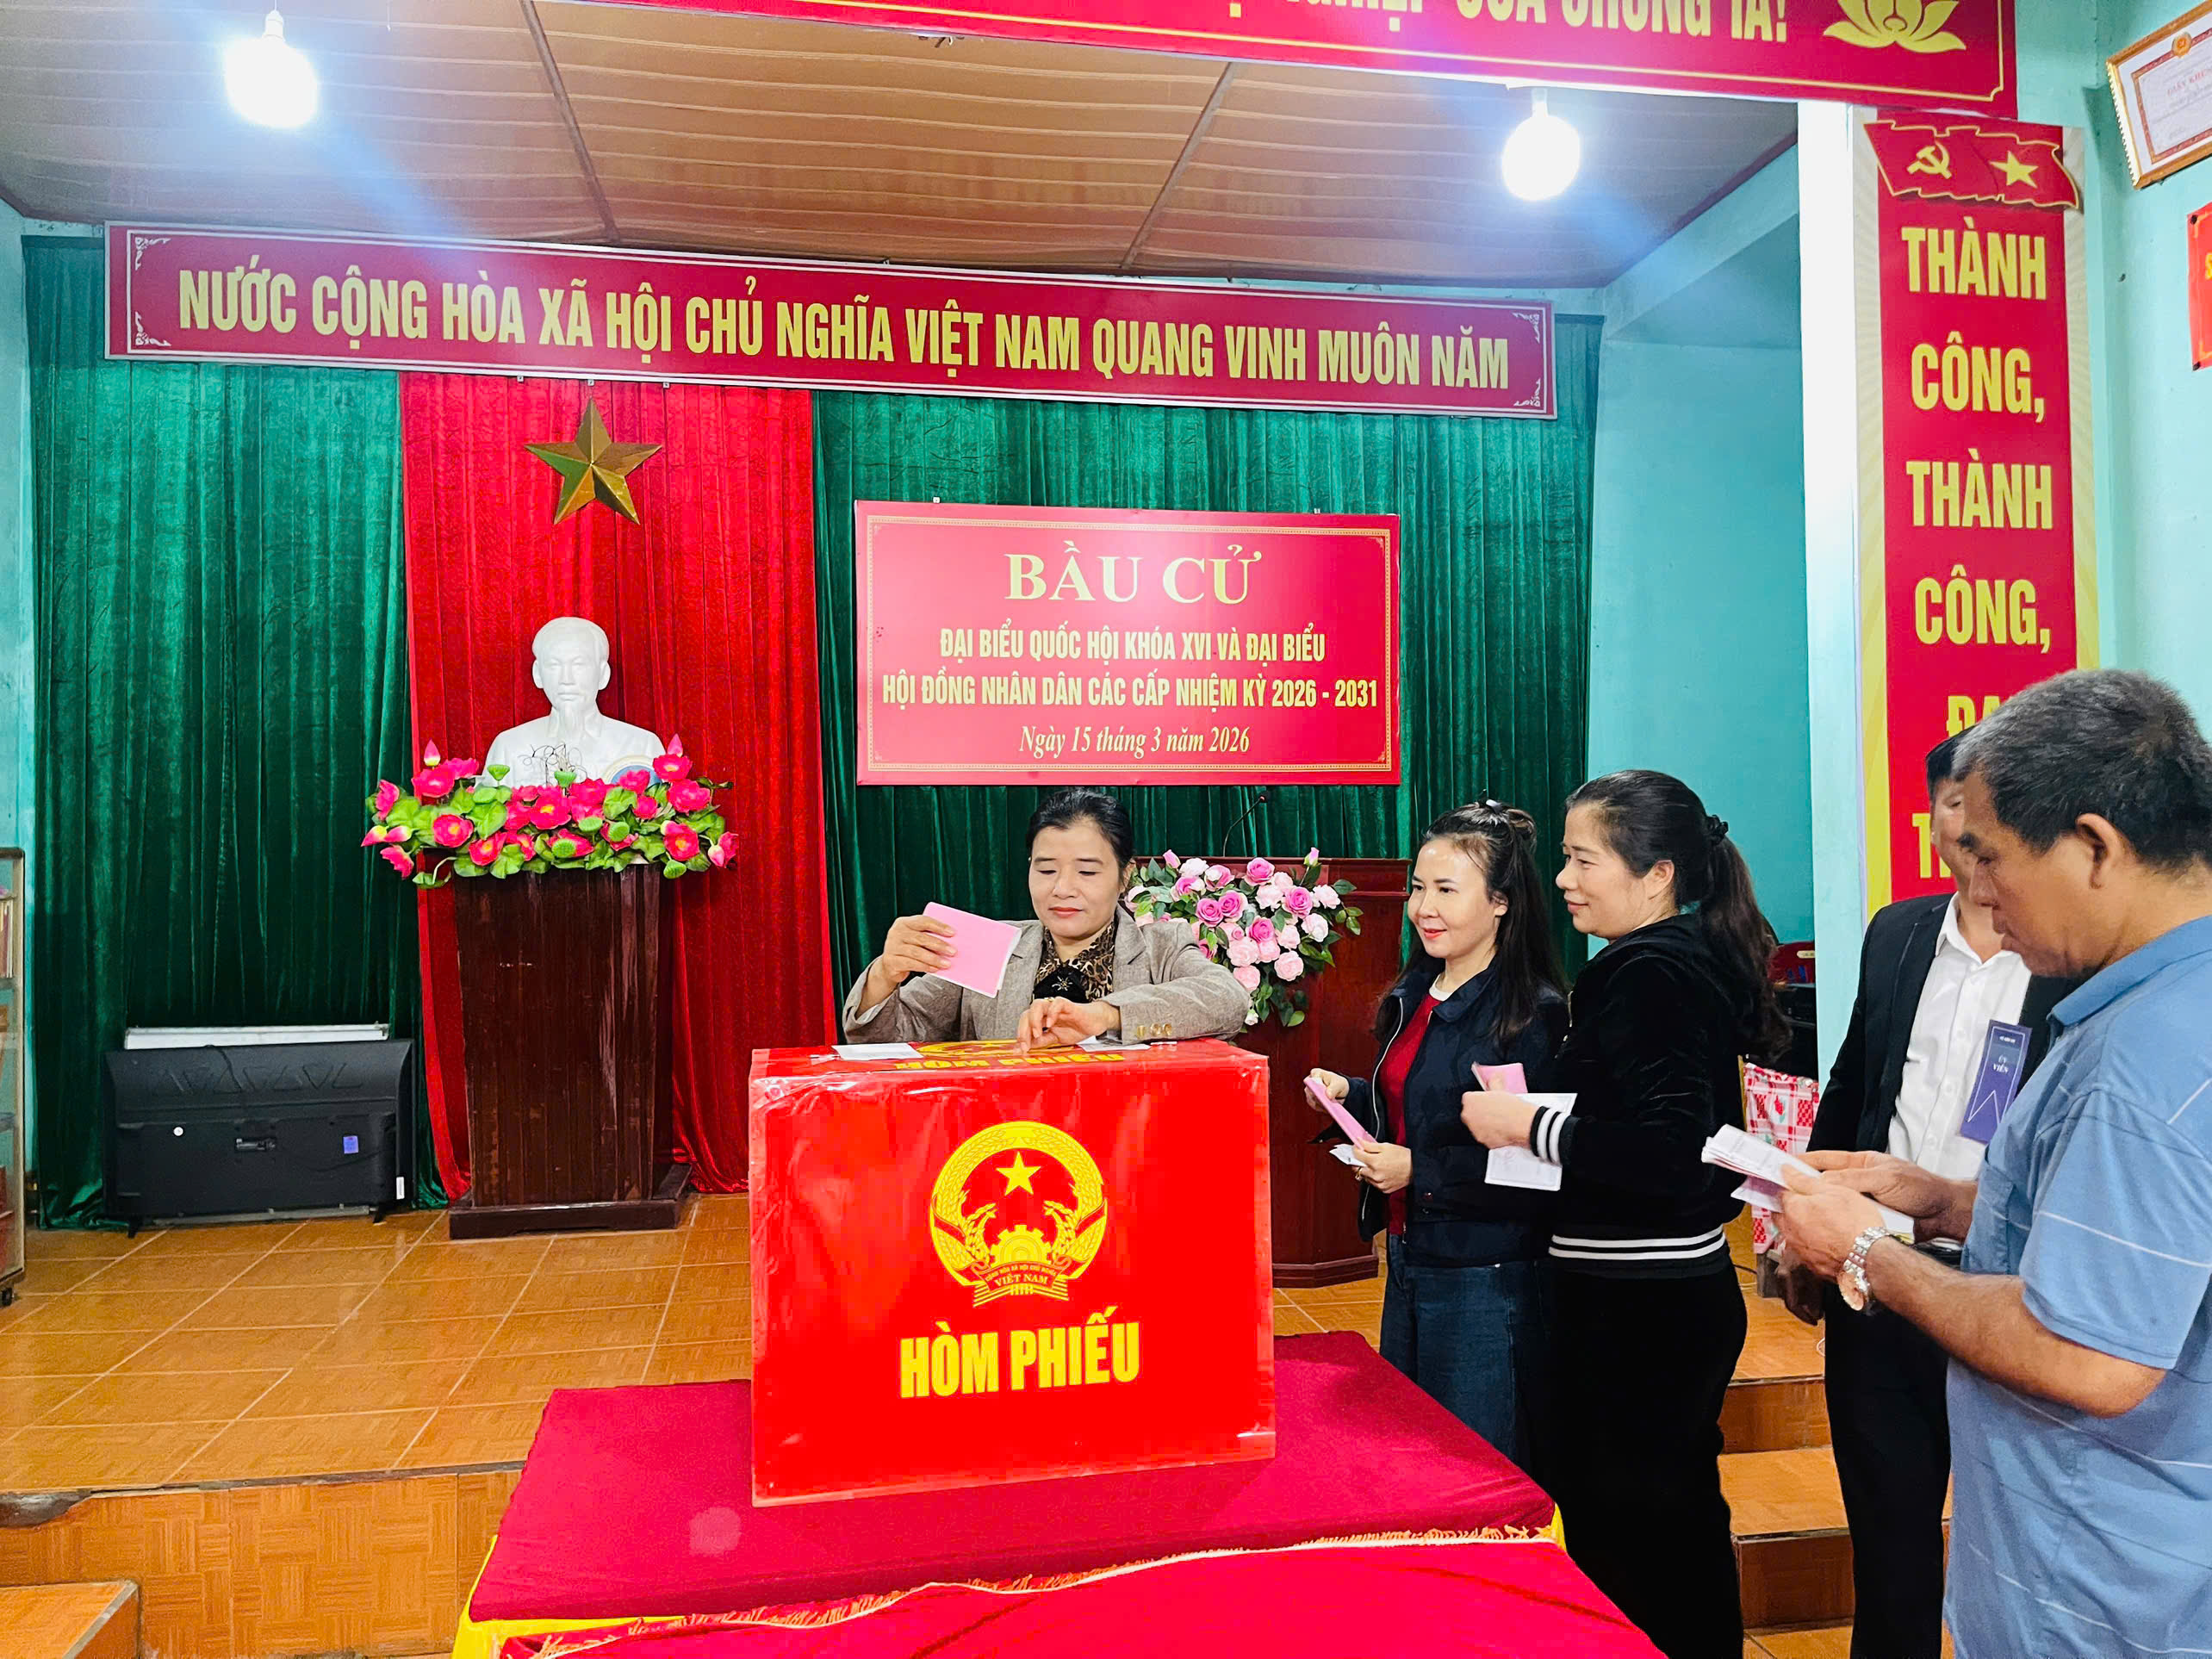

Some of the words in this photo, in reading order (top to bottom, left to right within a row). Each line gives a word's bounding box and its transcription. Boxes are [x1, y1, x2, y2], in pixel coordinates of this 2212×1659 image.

[1901, 216, 2047, 300] THÀNH
[179, 255, 297, 332] NƯỚC
[312, 265, 428, 350] CỘNG
[443, 270, 525, 345] HÒA
[540, 278, 593, 347] XÃ
[606, 283, 672, 363] HỘI
[686, 275, 763, 356] CHỦ
[776, 295, 894, 362] NGHĨA
[906, 299, 983, 378] VIỆT
[996, 314, 1080, 371] NAM
[1093, 319, 1214, 380] QUANG
[1225, 326, 1306, 381] VINH
[1318, 321, 1420, 386] MUÔN
[1432, 326, 1508, 389] NĂM
[1911, 331, 2045, 423] CÔNG,
[1905, 448, 2054, 530] THÀNH
[1003, 540, 1141, 602] BẦU
[1163, 544, 1262, 605] CỬ
[1915, 564, 2051, 654] CÔNG,
[940, 627, 973, 665] ĐẠI
[979, 618, 1024, 661] BIỂU
[1029, 620, 1082, 662] QUỐC
[1087, 624, 1121, 667] HỘI
[1125, 625, 1176, 661] KHÓA
[1181, 632, 1212, 661] XVI
[1216, 626, 1241, 662] VÀ
[1246, 632, 1277, 668] ĐẠI
[1283, 622, 1326, 662] BIỂU
[882, 668, 916, 711] HỘI
[922, 666, 976, 705] ĐỒNG
[981, 671, 1037, 705] NHÂN
[1041, 671, 1083, 705] DÂN
[1088, 669, 1127, 706] CÁC
[1132, 668, 1171, 706] CẤP
[1176, 673, 1238, 713] NHIỆM
[1242, 673, 1266, 706] KỲ
[1272, 679, 1317, 707] 2026
[1335, 679, 1377, 707] 2031
[1019, 725, 1066, 759] Ngày
[1072, 726, 1091, 752] 15
[1096, 726, 1146, 759] tháng
[1151, 727, 1161, 752] 3
[1165, 728, 1204, 752] năm
[1209, 727, 1251, 752] 2026
[900, 1320, 1000, 1399] HÒM
[1010, 1305, 1141, 1391] PHIẾU
